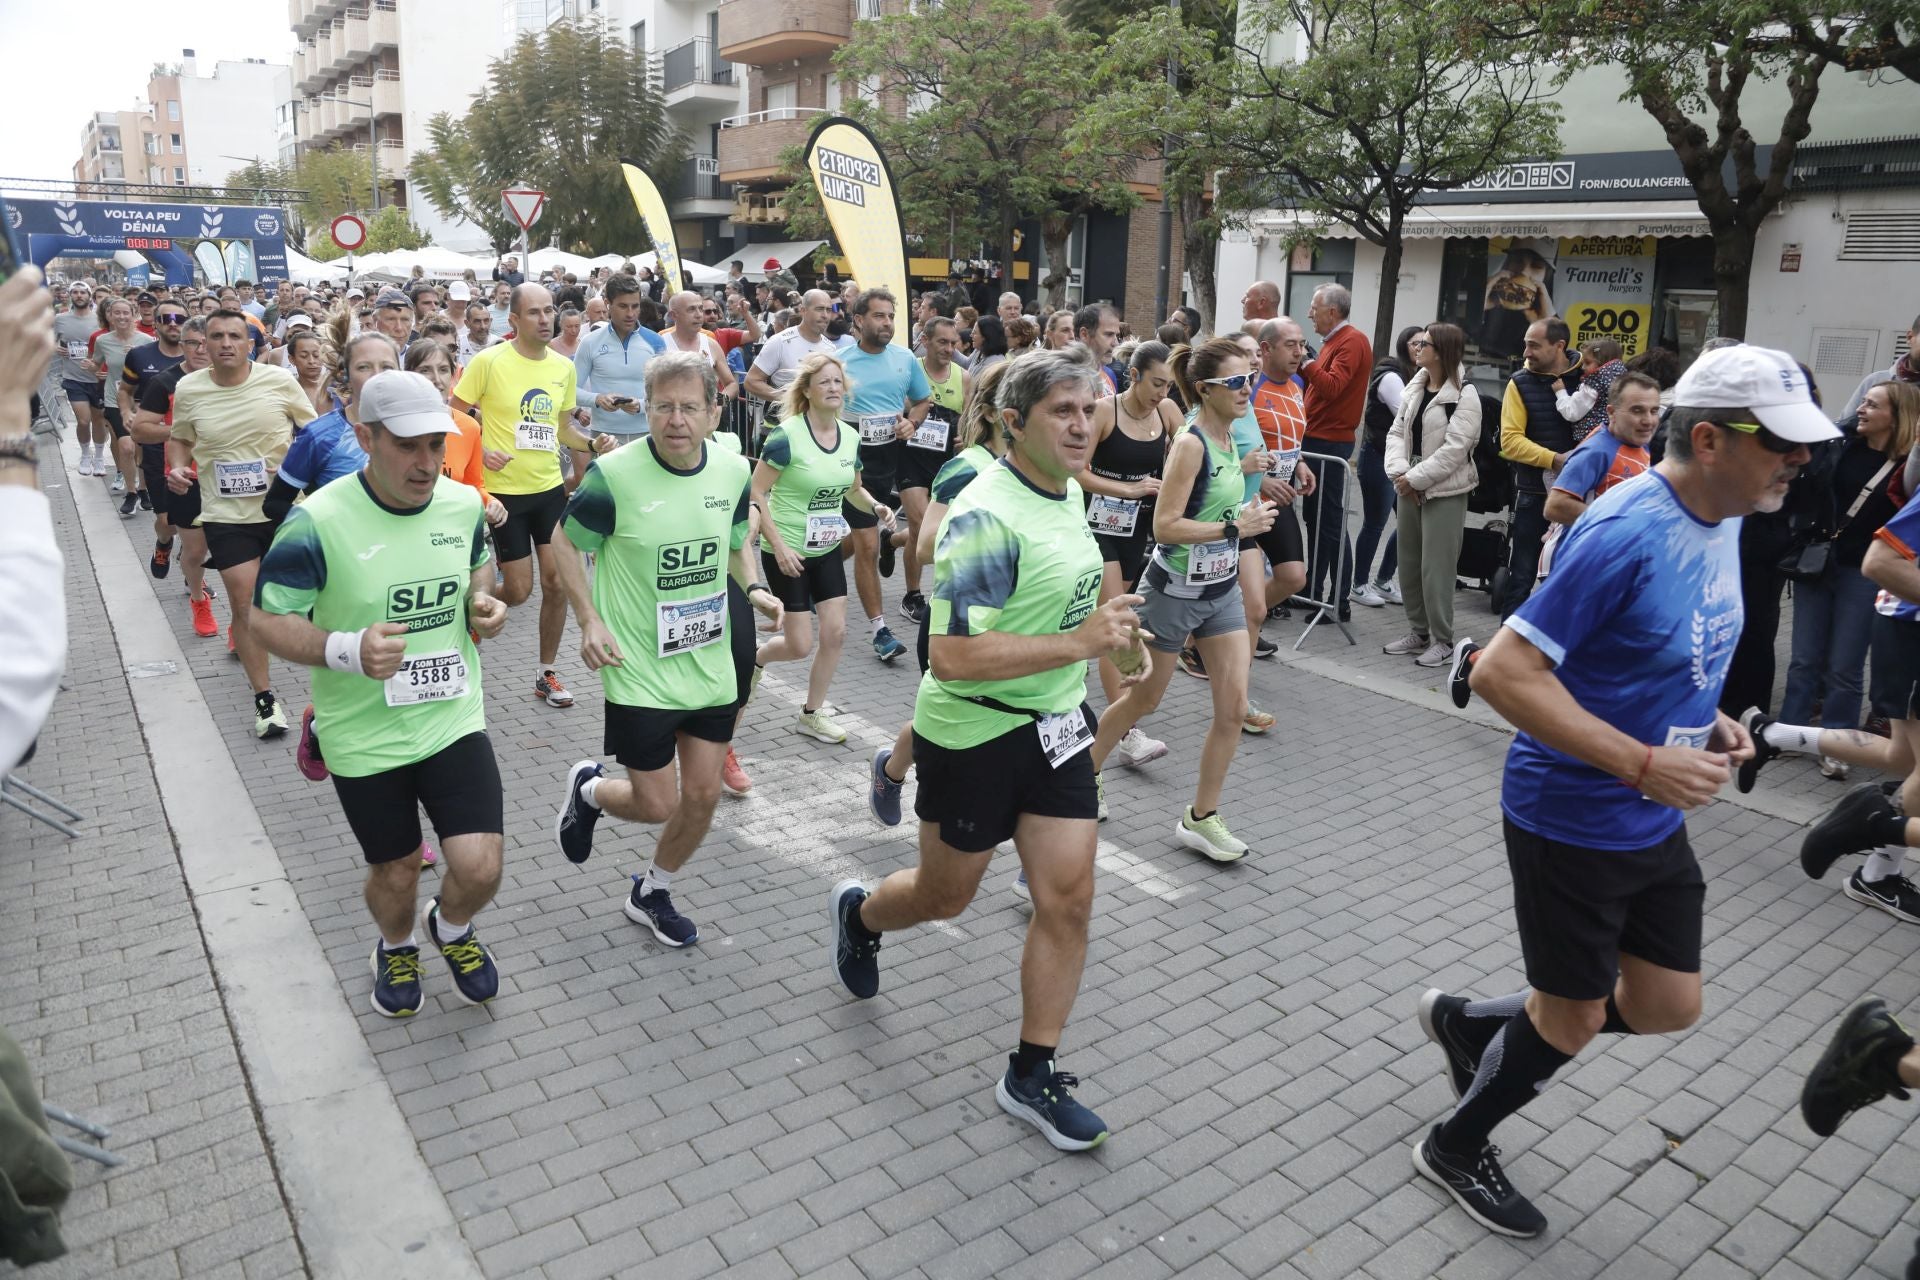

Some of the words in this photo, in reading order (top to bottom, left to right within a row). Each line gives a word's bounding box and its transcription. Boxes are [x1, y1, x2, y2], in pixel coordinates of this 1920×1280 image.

[104, 210, 144, 220] VOLTA
[145, 211, 155, 220] A
[156, 212, 181, 221] PEU
[122, 221, 166, 233] DÉNIA
[1638, 223, 1693, 234] PuraMasa
[1570, 244, 1643, 256] APERTURA
[1566, 267, 1644, 285] Fanneli's
[1608, 283, 1643, 294] burgers
[1579, 308, 1640, 334] 200
[528, 430, 548, 440] 3481
[873, 428, 888, 437] 684
[1094, 467, 1122, 479] TRAINING
[220, 479, 227, 487] B
[230, 477, 251, 487] 733
[1092, 512, 1099, 521] S
[1106, 515, 1120, 525] 46
[812, 532, 817, 540] E
[821, 530, 838, 541] 272
[661, 541, 719, 571] SLP
[1196, 562, 1203, 572] E
[1210, 558, 1228, 572] 133
[660, 570, 716, 588] BARBACOAS
[1070, 573, 1102, 606] SLP
[391, 580, 459, 613] SLP
[668, 628, 675, 640] E
[683, 620, 707, 637] 598
[415, 660, 434, 669] SOM
[410, 667, 450, 686] 3588
[1057, 719, 1074, 742] 463
[1042, 734, 1051, 749] D
